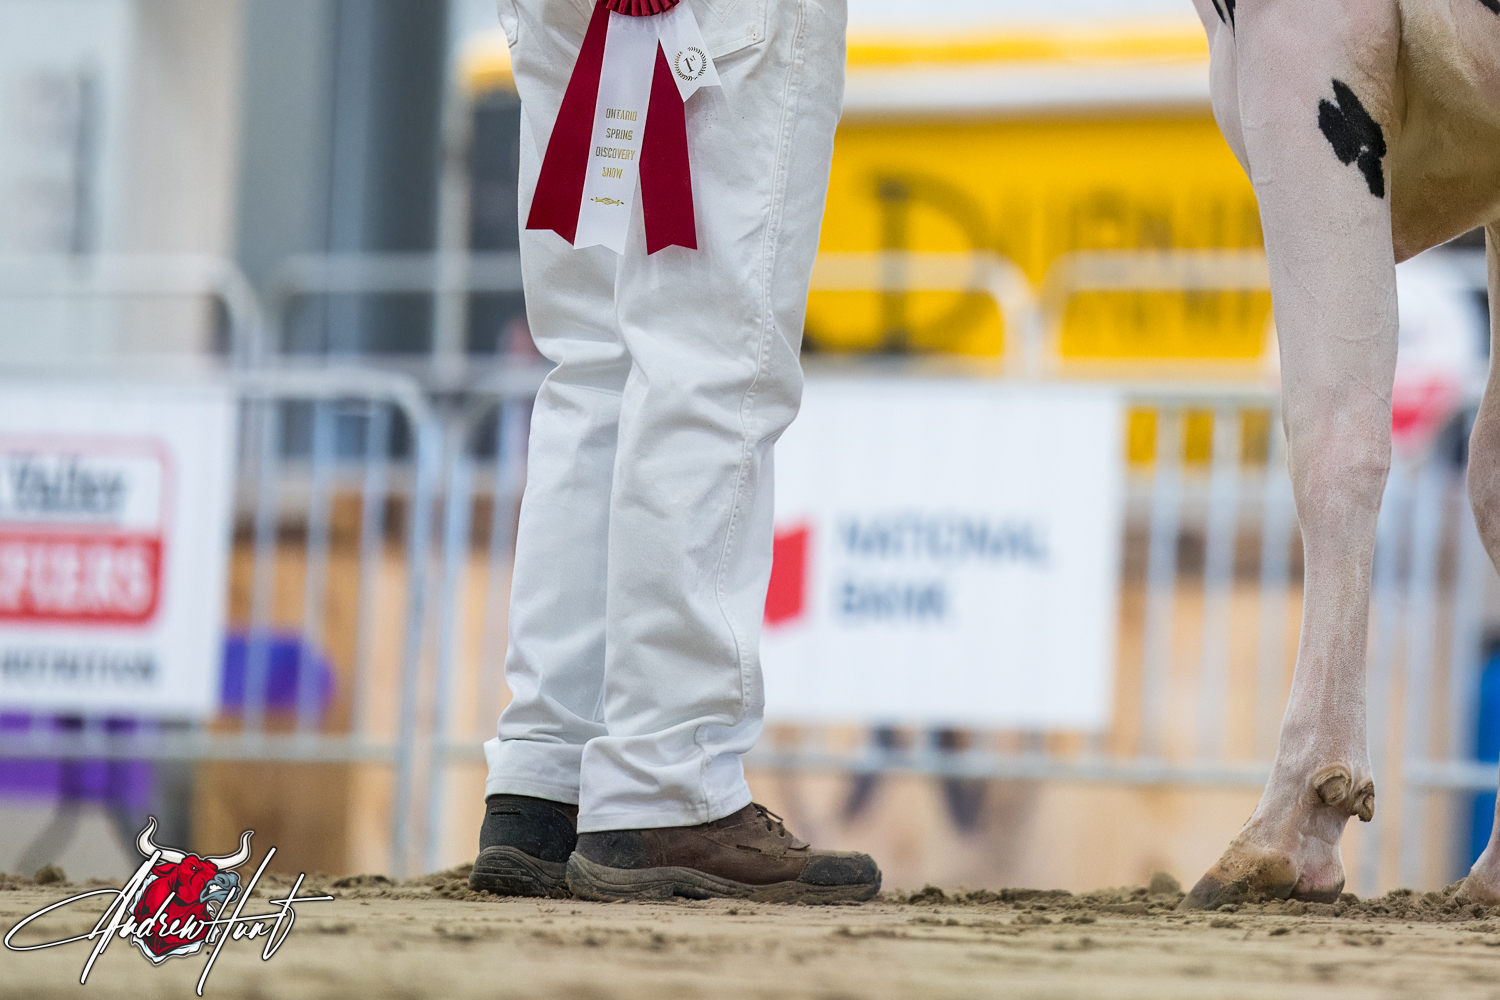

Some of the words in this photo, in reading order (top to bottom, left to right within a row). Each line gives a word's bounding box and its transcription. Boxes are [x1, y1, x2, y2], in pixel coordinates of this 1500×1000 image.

[605, 108, 638, 122] ONTARIO
[605, 127, 634, 141] SPRING
[595, 146, 636, 161] DISCOVERY
[601, 166, 624, 179] SHOW
[839, 513, 1053, 566] NATIONAL
[838, 575, 952, 623] BANK
